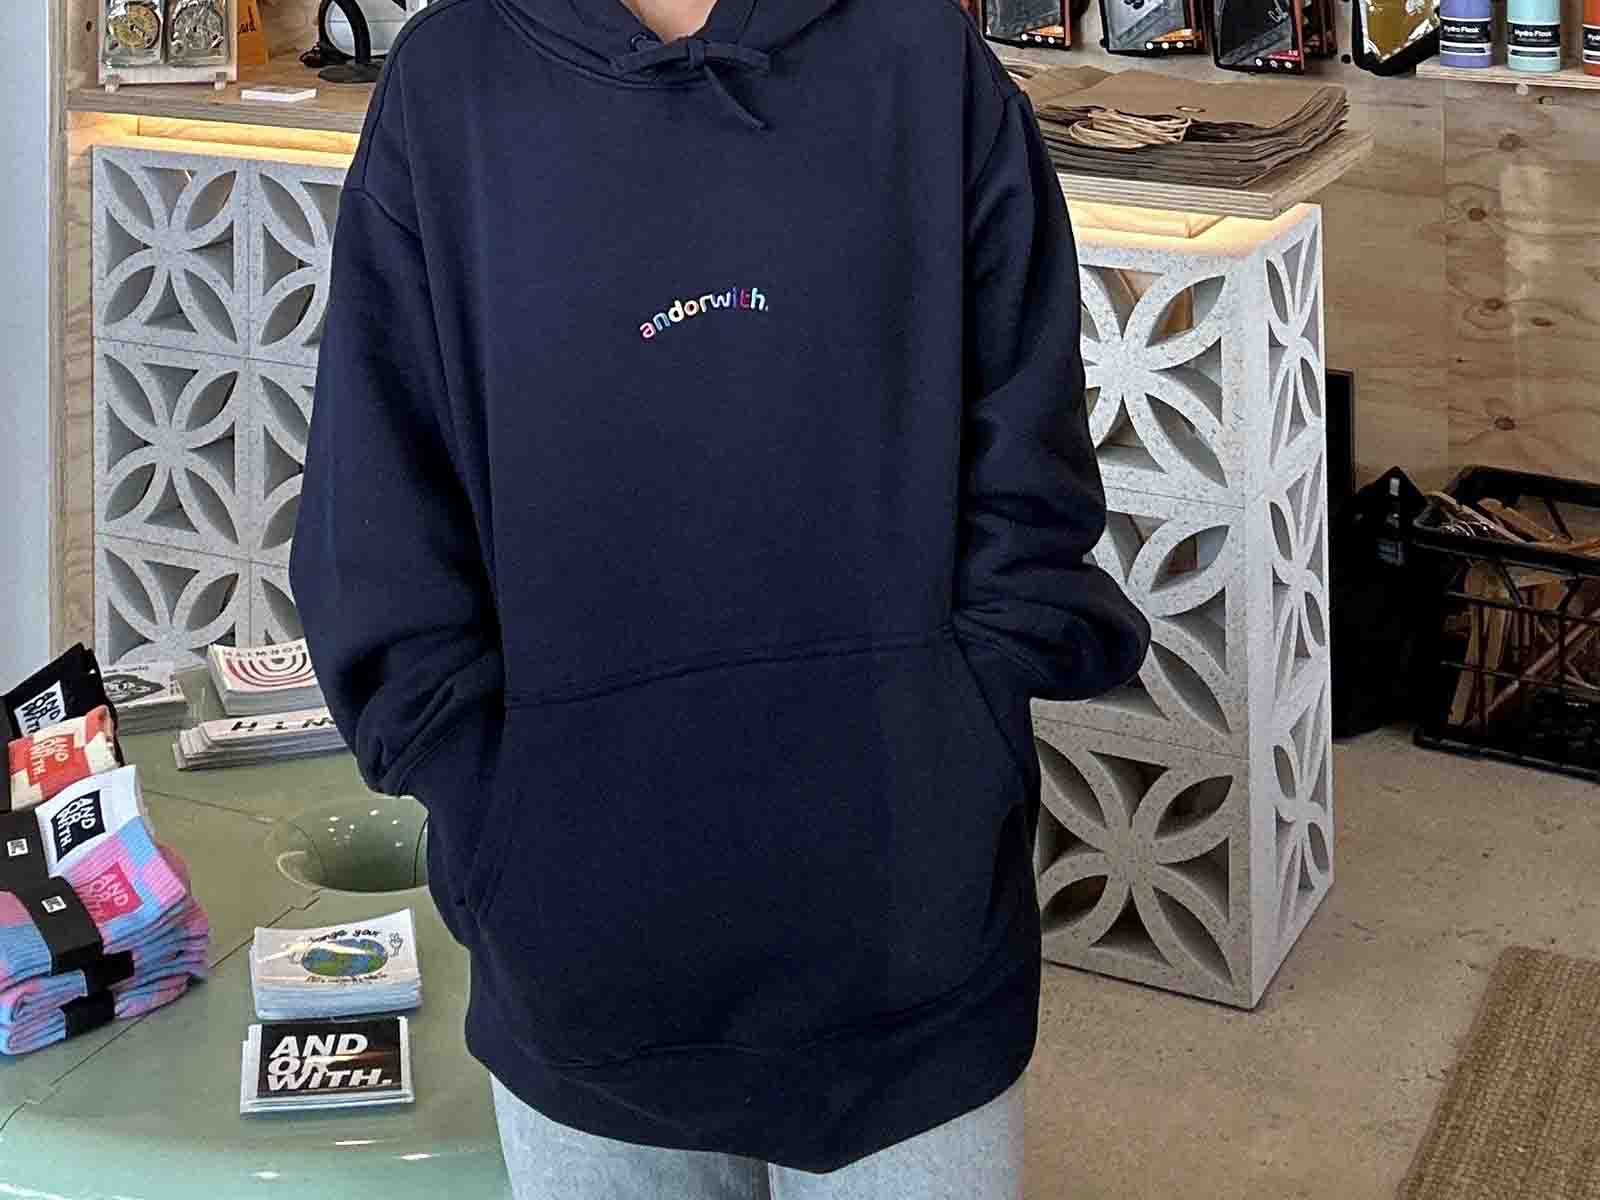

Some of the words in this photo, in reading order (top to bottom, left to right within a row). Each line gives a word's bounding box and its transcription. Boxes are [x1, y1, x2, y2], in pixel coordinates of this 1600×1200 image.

[34, 697, 48, 717] OR
[44, 691, 61, 720] AND
[55, 735, 69, 762] AND
[67, 802, 81, 823] OR
[79, 798, 97, 830] AND
[101, 873, 129, 907] AND
[269, 1033, 368, 1058] AND
[266, 1067, 393, 1091] WITH.
